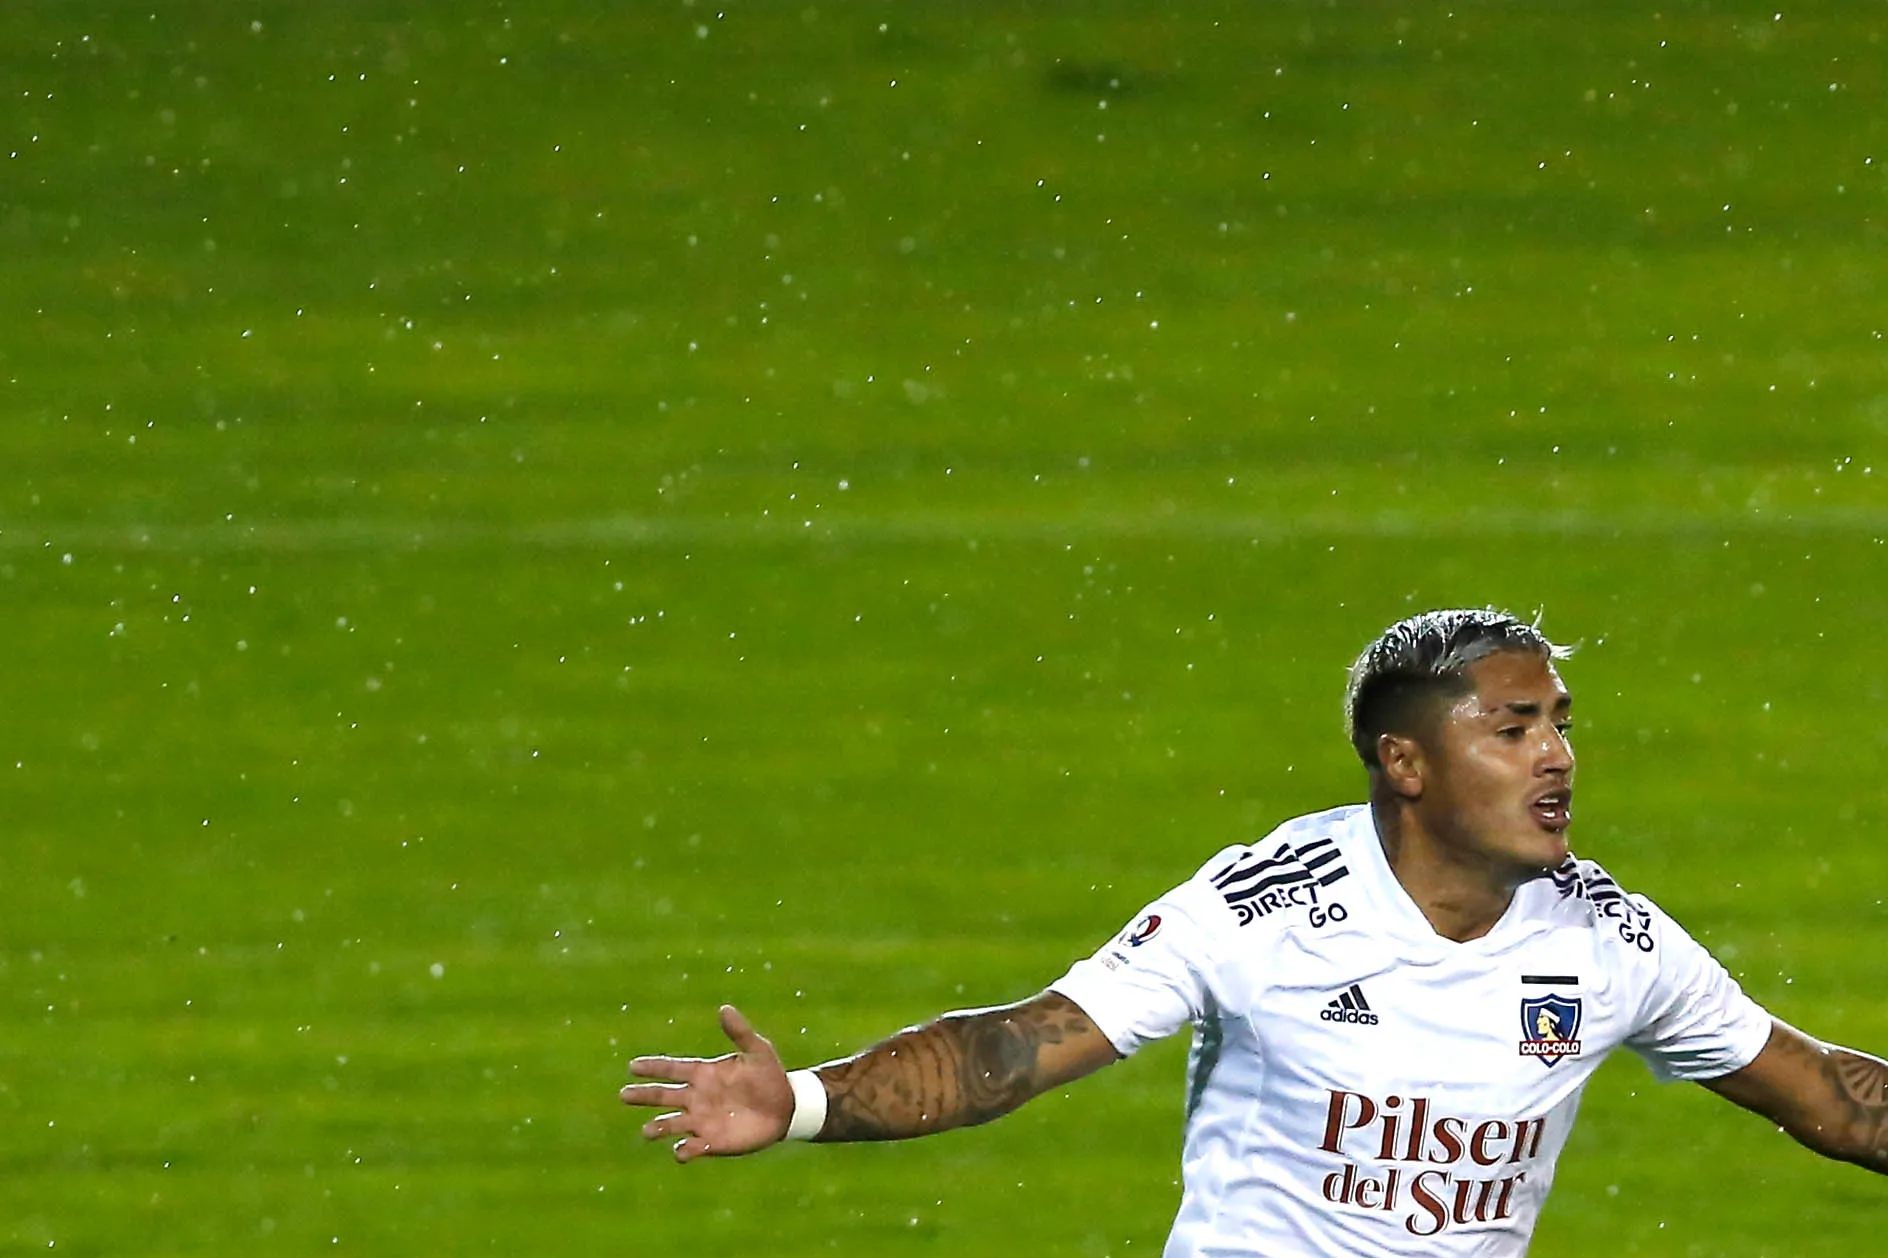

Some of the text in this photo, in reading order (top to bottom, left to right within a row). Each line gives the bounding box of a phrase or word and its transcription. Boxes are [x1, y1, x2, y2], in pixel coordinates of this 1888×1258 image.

[1309, 902, 1348, 928] GO
[1619, 922, 1655, 953] GO
[1320, 1006, 1379, 1026] adidas
[1521, 1042, 1579, 1055] COLO-COLO
[1317, 1087, 1546, 1168] Pilsen
[1322, 1163, 1528, 1236] del Sur
